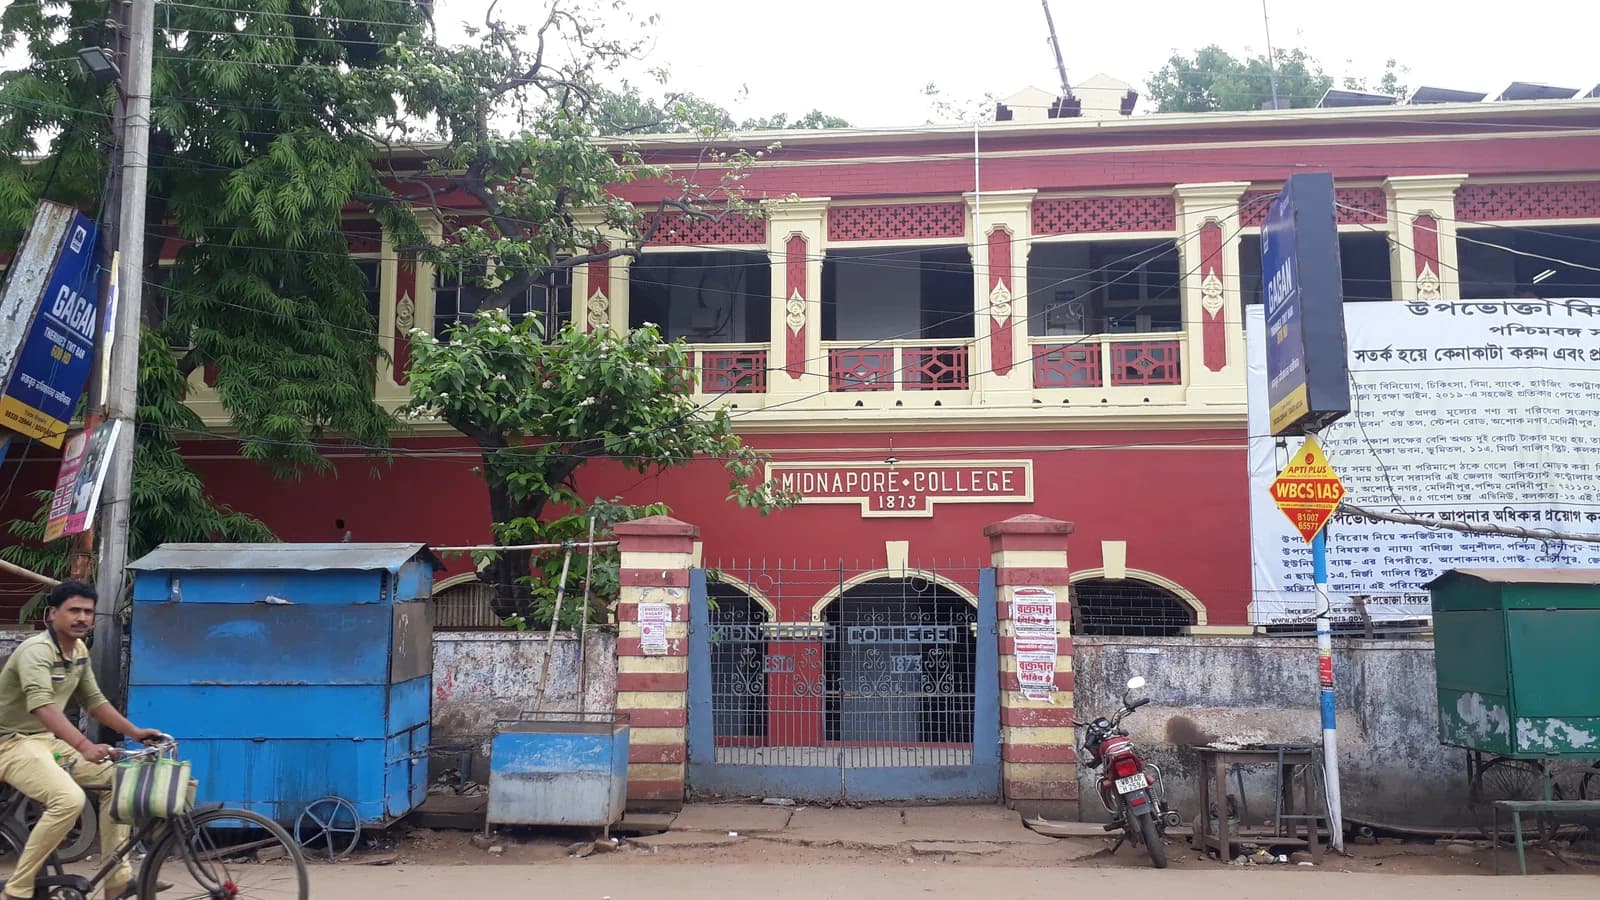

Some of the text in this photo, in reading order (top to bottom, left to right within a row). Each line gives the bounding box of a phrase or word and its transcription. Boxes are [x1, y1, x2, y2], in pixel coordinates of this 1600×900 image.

[1267, 256, 1293, 315] GAGAN
[52, 284, 97, 339] GAGAN
[1405, 301, 1552, 316] উপভোক্তা
[1489, 323, 1582, 338] পশ্চিমবঙ্গ
[1353, 344, 1392, 362] সতর্ক
[1396, 349, 1427, 364] হয়ে
[1435, 342, 1503, 361] কেনাকাটা
[1508, 347, 1548, 360] করুন
[1553, 349, 1586, 362] এবং
[782, 471, 1015, 494] MIDNAPORE COLLEGE
[1276, 483, 1315, 499] WBCS
[1317, 483, 1340, 500] IAS
[878, 495, 917, 509] 1873
[1438, 508, 1490, 523] আপনার
[1493, 506, 1541, 522] অধিকার
[1544, 508, 1581, 523] প্রয়োগ
[849, 626, 947, 643] COLLEGE
[890, 655, 922, 673] 1873
